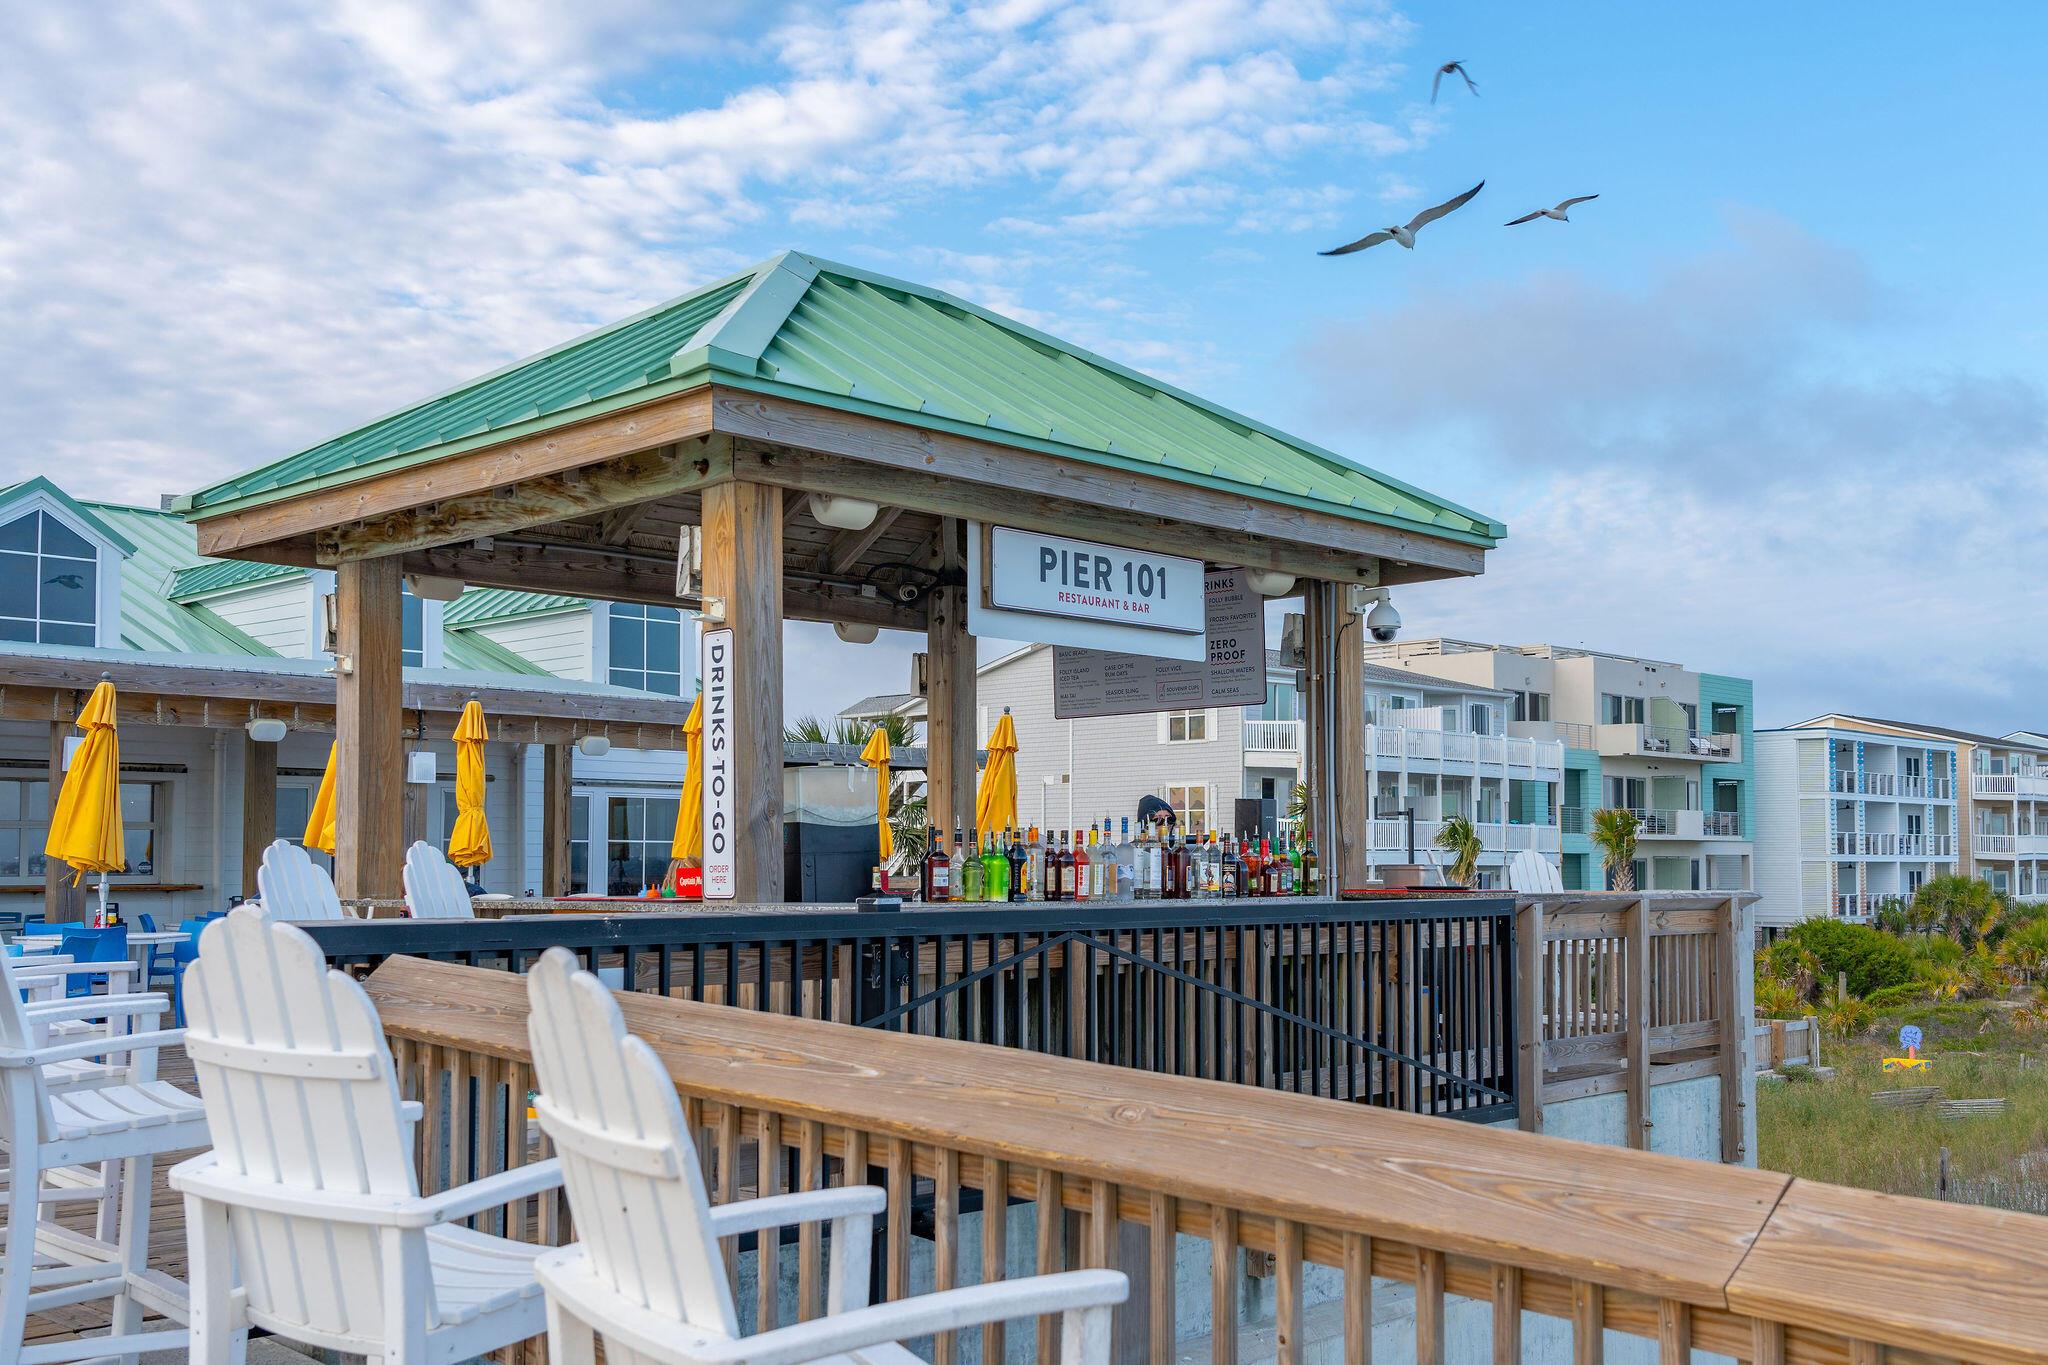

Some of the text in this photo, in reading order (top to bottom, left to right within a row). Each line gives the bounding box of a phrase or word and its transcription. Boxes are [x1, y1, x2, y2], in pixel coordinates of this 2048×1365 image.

[1040, 547, 1166, 600] PIER 101
[1205, 578, 1234, 591] RINKS
[1058, 592, 1150, 614] RESTAURANT & BAR
[1210, 612, 1257, 623] FROZEN FAVORITES
[1210, 638, 1237, 650] ZERO
[1211, 650, 1246, 662] PROOF
[1210, 668, 1235, 676] SHALLOW
[1236, 666, 1256, 674] WATERS
[1105, 688, 1124, 696] SEASIDE
[1226, 686, 1240, 694] SEAS
[712, 644, 726, 854] DRINKS TO-GO
[708, 865, 729, 874] ORDER
[712, 876, 727, 884] HERE
